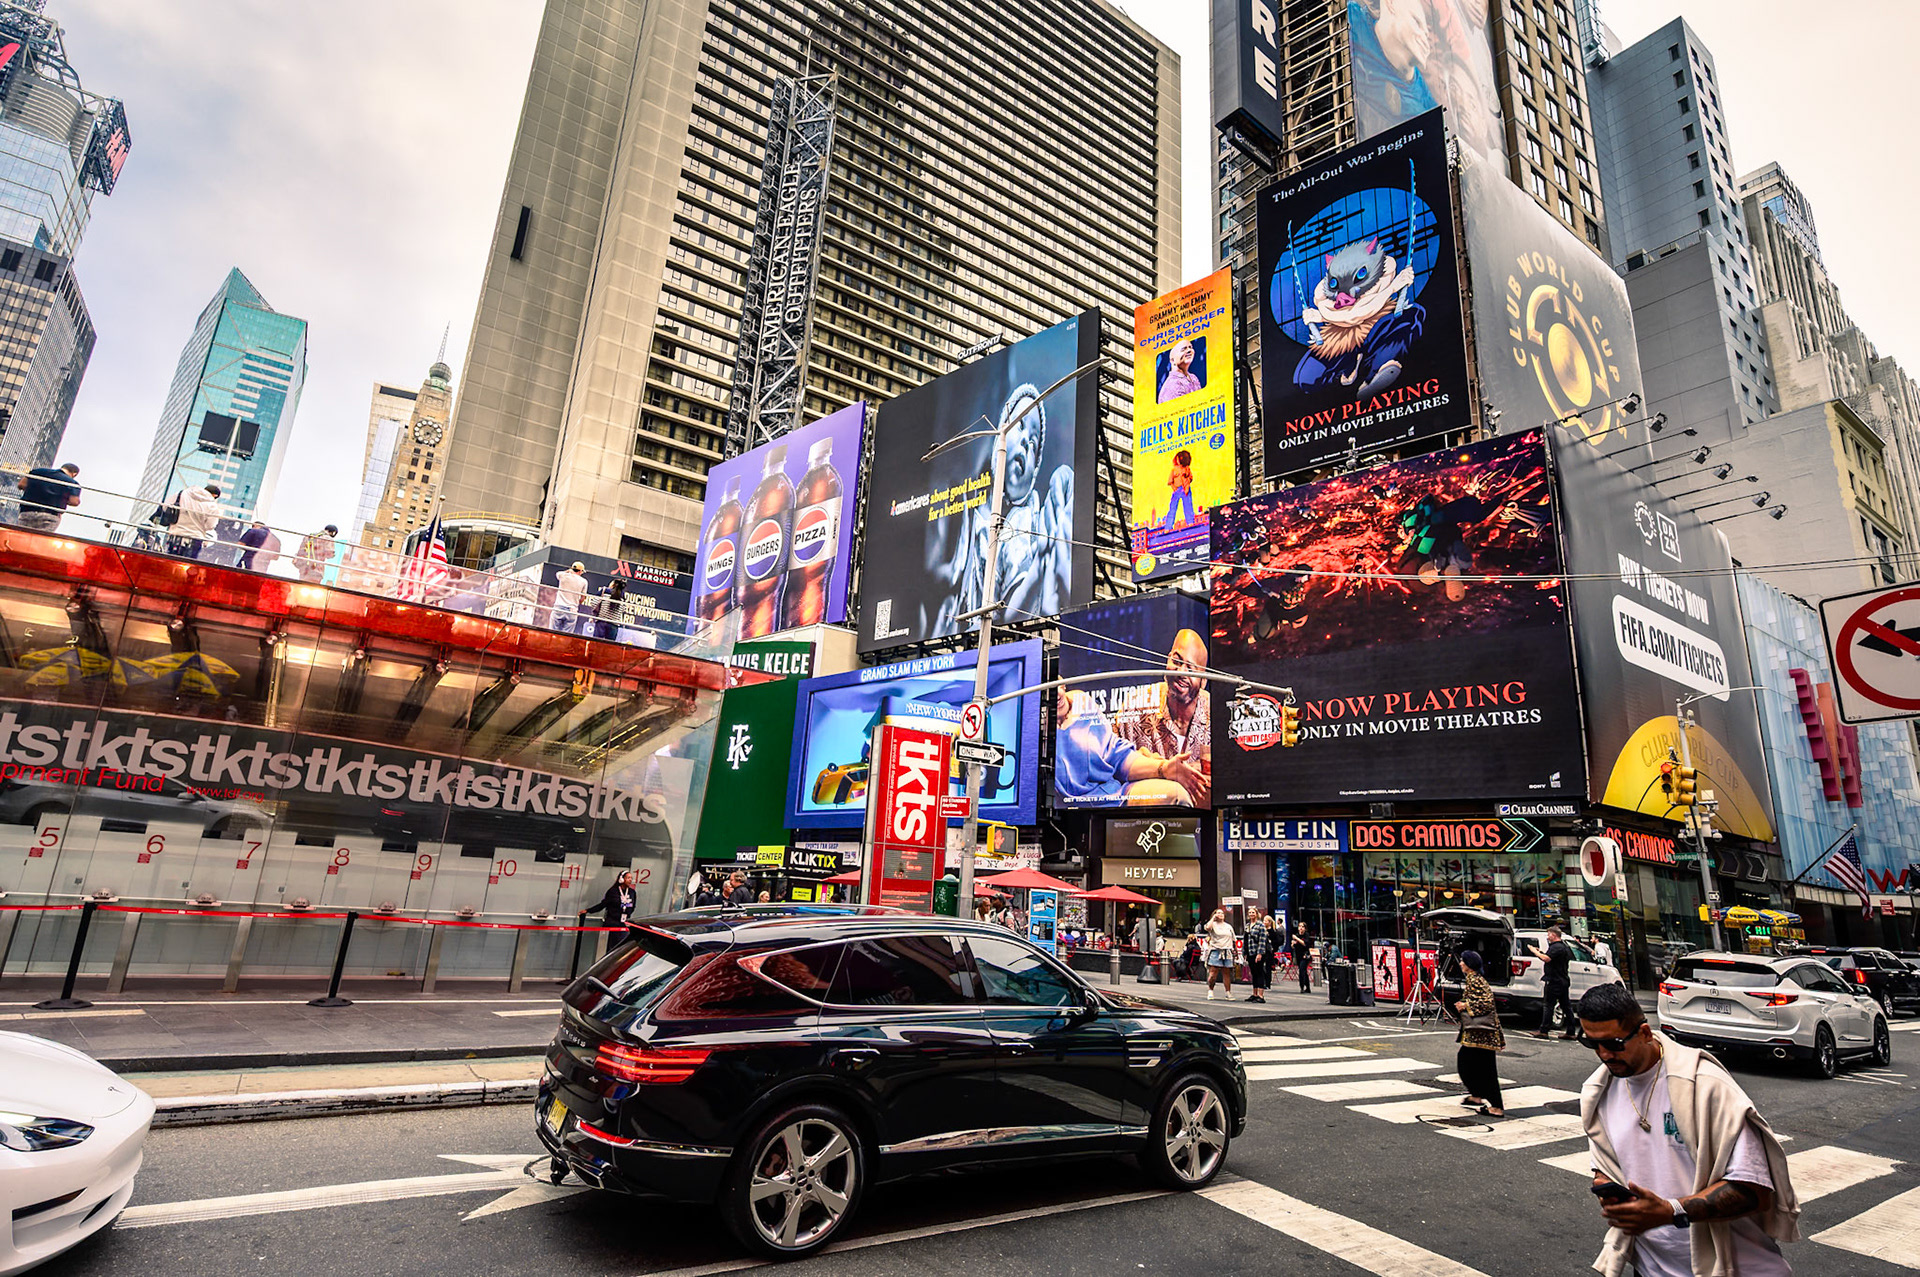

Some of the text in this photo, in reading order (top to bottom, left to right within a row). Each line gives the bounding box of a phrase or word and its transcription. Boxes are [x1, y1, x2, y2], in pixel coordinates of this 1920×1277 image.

[1272, 129, 1424, 203] The All-Out War Begins
[761, 162, 801, 355] AMERICAN EAGLE
[785, 188, 817, 323] OUTFITTERS
[1139, 306, 1225, 347] CHRISTOPHER
[1156, 303, 1207, 331] AWARD WINNER
[1506, 273, 1527, 368] CLUB
[1517, 250, 1584, 303] WORLD
[1592, 314, 1620, 384] CUP
[1153, 321, 1211, 350] JACKSON
[1285, 378, 1440, 436] NOW PLAYING
[1140, 420, 1173, 449] HELL'S
[1178, 402, 1226, 436] KITCHEN
[1278, 430, 1311, 450] ONLY
[1313, 427, 1328, 441] IN
[1331, 415, 1374, 436] MOVIE
[1376, 393, 1450, 423] THEATRES
[1158, 442, 1183, 454] ALICIA
[1184, 435, 1207, 446] KEYS
[929, 488, 950, 505] about
[949, 478, 968, 502] good
[967, 471, 991, 492] health
[944, 502, 966, 517] better
[966, 489, 987, 508] world
[794, 526, 827, 545] PIZZA
[746, 538, 780, 560] BURGERS
[636, 565, 679, 580] MARRIOTT
[708, 555, 733, 573] WINGS
[635, 572, 674, 586] MARQUIS
[1618, 552, 1709, 625] BUY TICKETS NOW
[624, 591, 657, 608] DUCING
[1619, 611, 1724, 686] FIFA.COM/TICKETS
[763, 653, 810, 675] KELCE
[861, 654, 955, 682] GRAND SLAM NEW YORK
[1071, 682, 1161, 715] HELL'S KITCHEN
[1305, 680, 1527, 721] NOW PLAYING
[1228, 718, 1281, 737] SLAYER
[1345, 721, 1364, 738] IN
[1368, 717, 1430, 736] MOVIE
[1434, 707, 1542, 731] THEATRES
[961, 747, 997, 760] ONE WAY
[1641, 731, 1739, 791] CLUB WRLD CUP
[97, 767, 166, 792] Fund
[893, 739, 941, 841] tkts
[185, 785, 265, 804] www.tdf.org
[887, 790, 895, 825] development
[38, 827, 59, 847] 5
[1229, 820, 1337, 838] BLUE FIN
[1356, 824, 1501, 847] DOS CAMINOS
[146, 834, 166, 855] 6
[247, 841, 262, 859] 7
[736, 852, 782, 861] TICKET CENTER
[1600, 827, 1677, 865] OS CAMINOS
[334, 848, 350, 867] 8
[417, 854, 432, 872] 9
[495, 859, 517, 877] 10
[790, 851, 836, 868] KLIKTIX
[566, 865, 581, 880] 11
[634, 868, 650, 885] 12
[1124, 867, 1173, 879] HEYTEA
[1866, 867, 1909, 893] W
